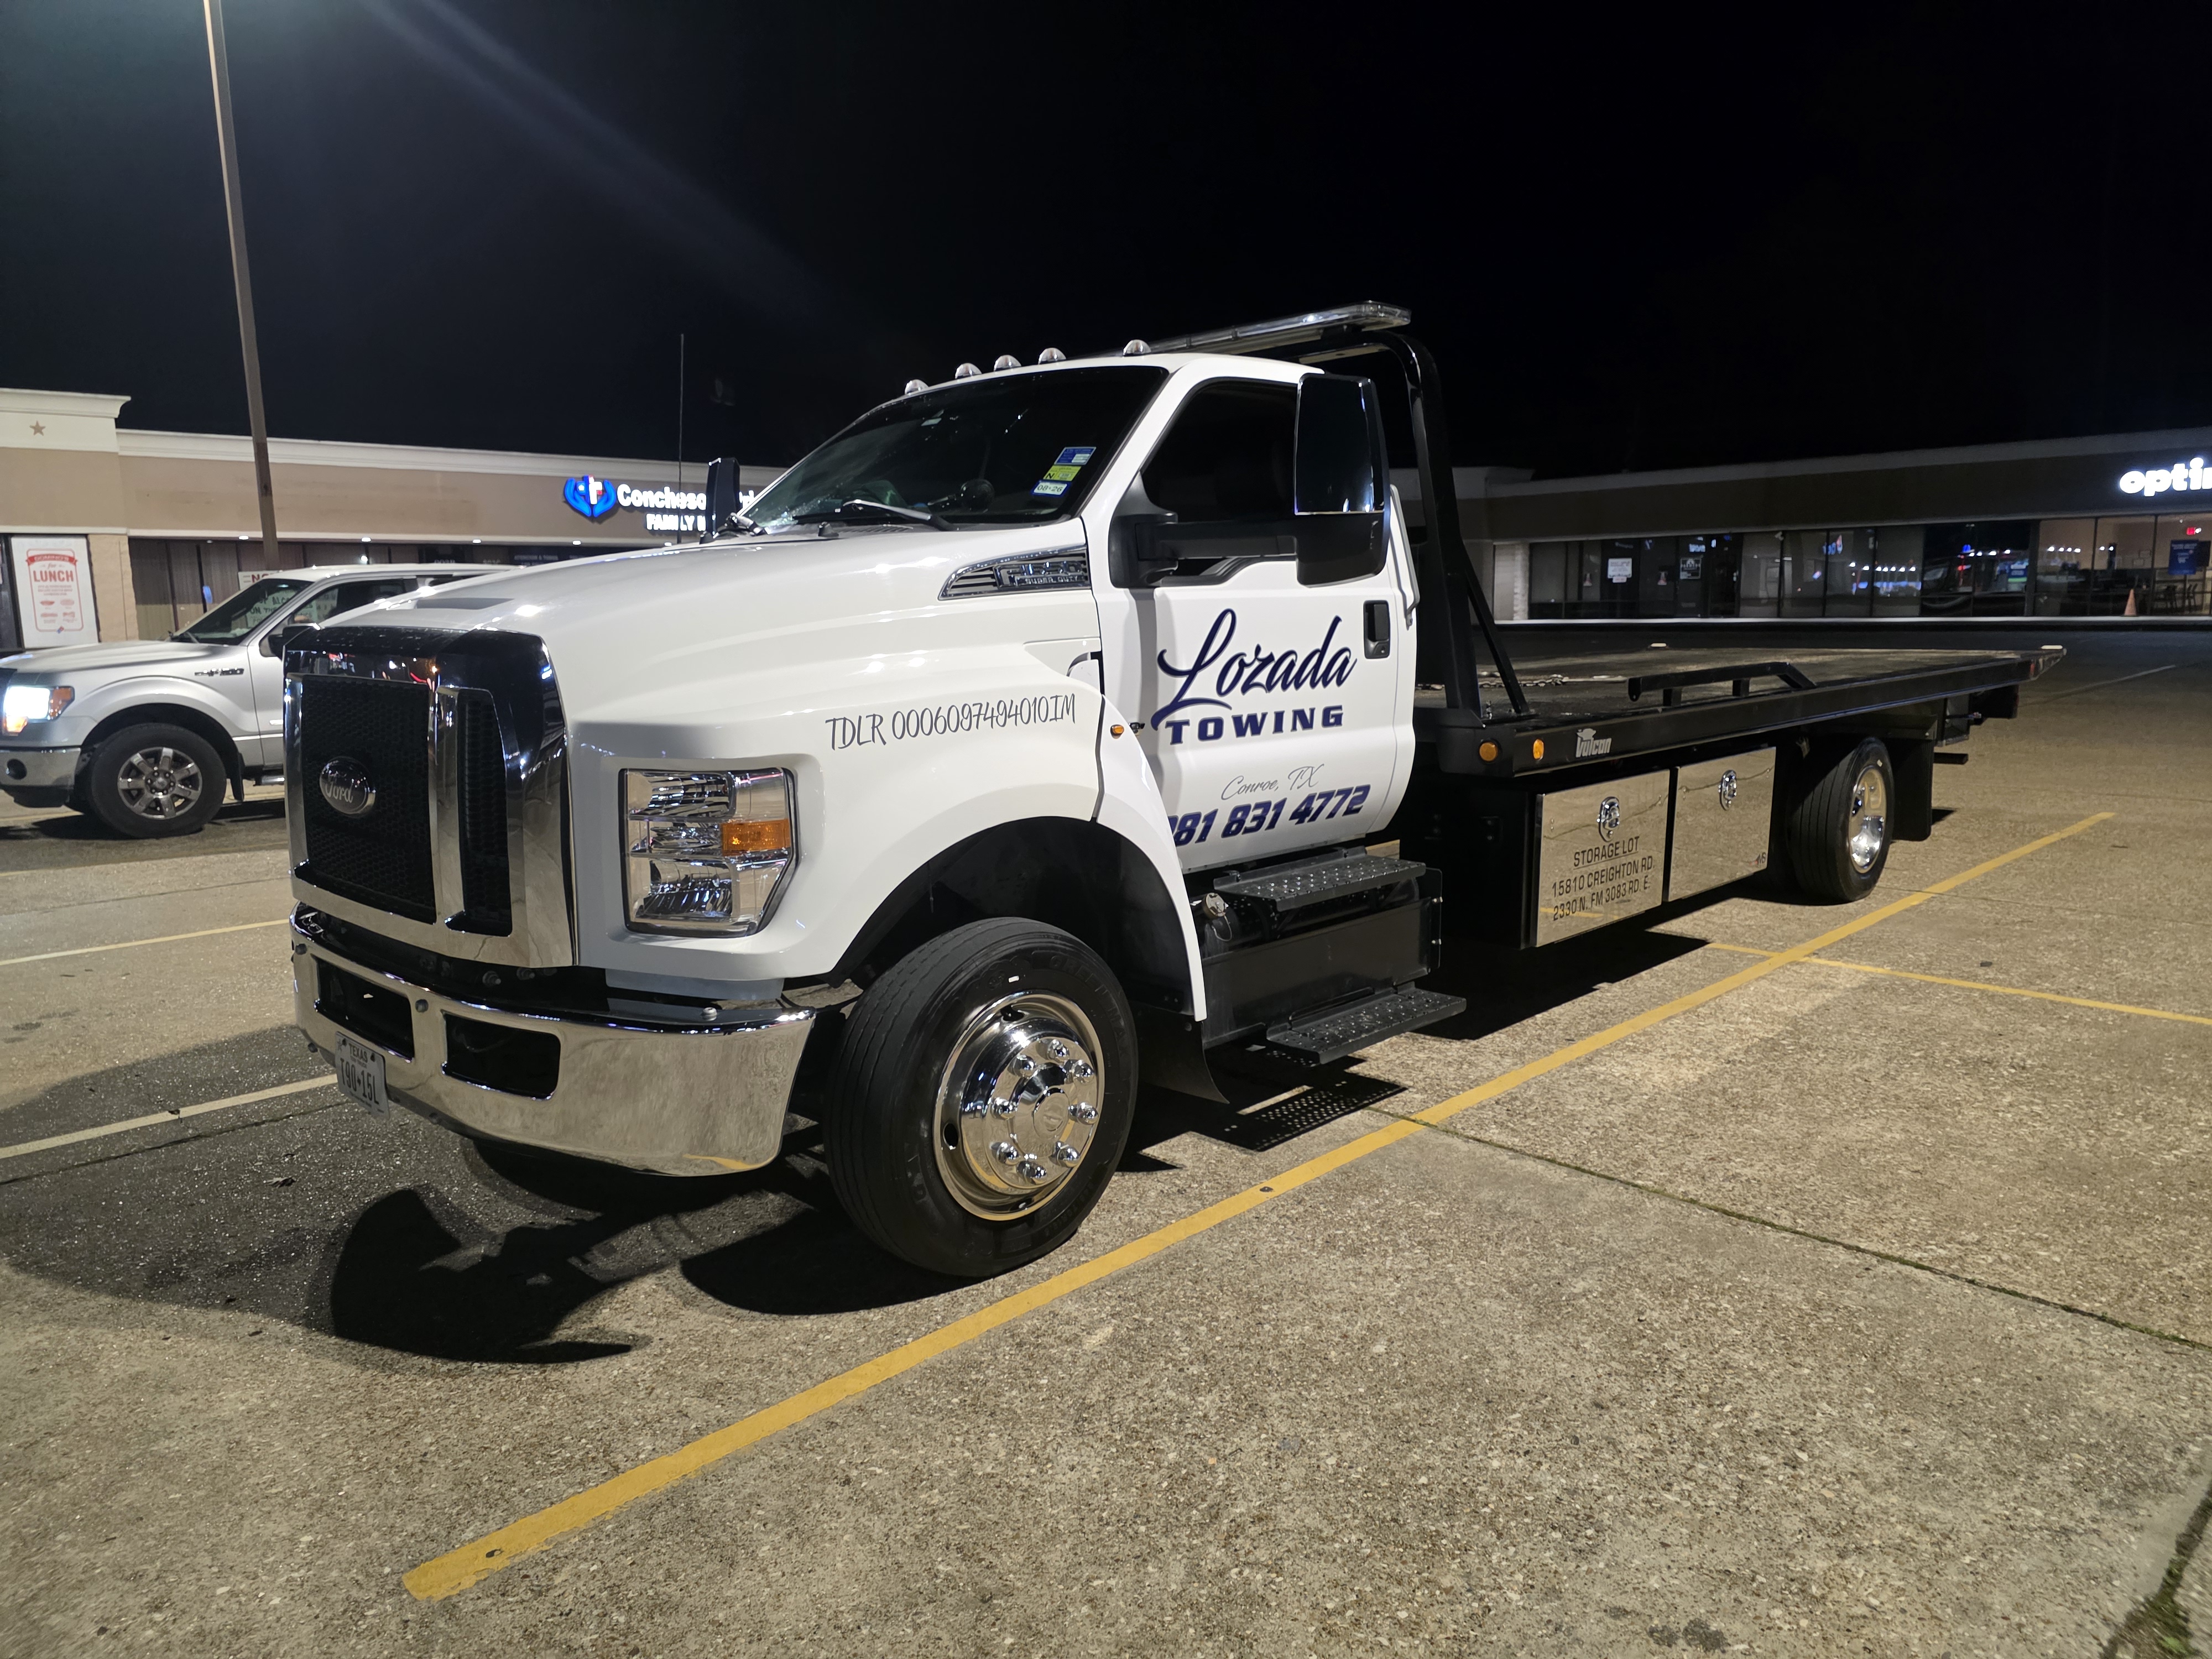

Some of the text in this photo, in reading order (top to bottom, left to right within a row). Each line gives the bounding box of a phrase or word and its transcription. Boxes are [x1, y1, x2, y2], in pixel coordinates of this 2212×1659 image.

[646, 513, 695, 531] FAMILY
[33, 570, 74, 582] LUNCH
[1151, 608, 1357, 731] Lozada
[825, 713, 886, 750] TDLR
[1165, 705, 1343, 745] TOWING
[325, 771, 353, 804] Ford
[1220, 764, 1324, 801] Conroe, TX
[1220, 797, 1287, 839] 831
[1288, 784, 1371, 826] 4772
[1574, 836, 1640, 867] STORAGE LOT
[1552, 855, 1655, 898] 15810 CREIGHTON RD.
[1553, 899, 1577, 921] 2330
[1579, 896, 1588, 912] N.
[1591, 890, 1603, 907] FM
[1605, 883, 1627, 903] 3083
[348, 1043, 368, 1063] TEXAS
